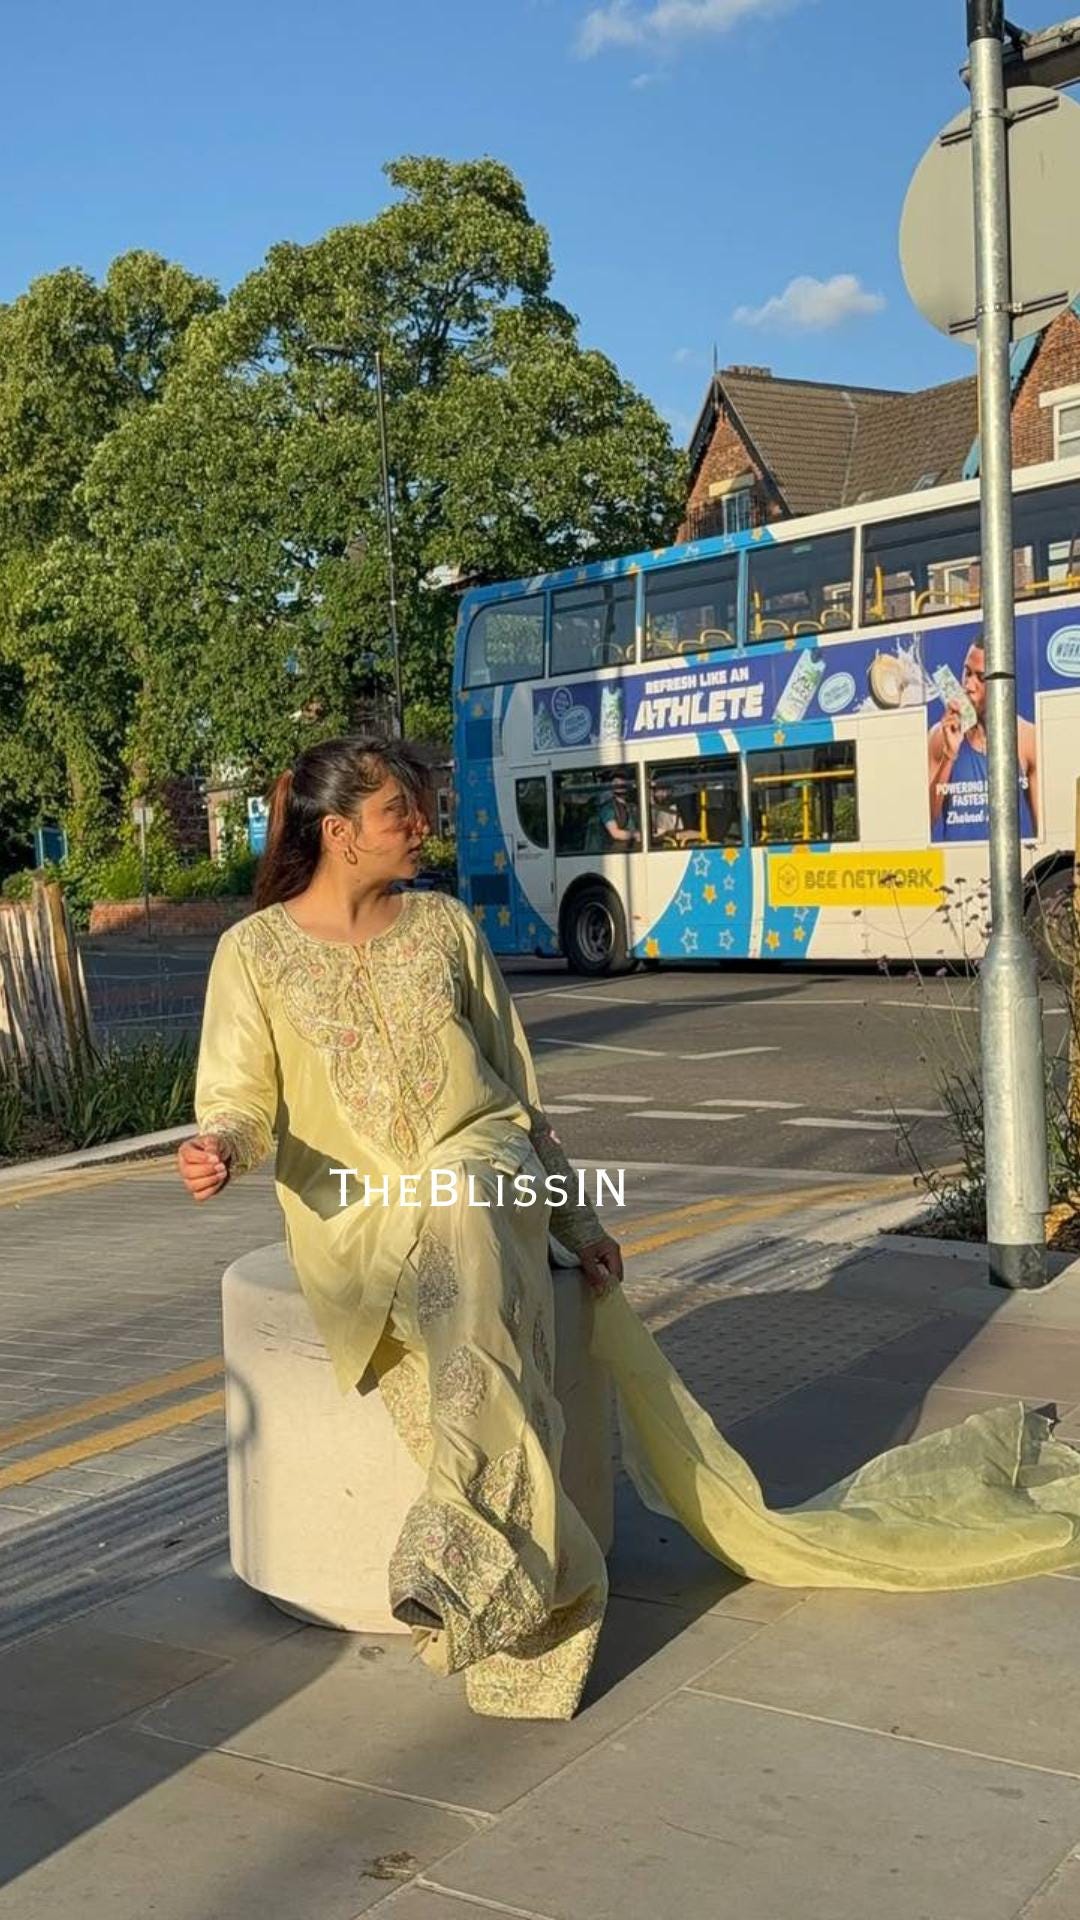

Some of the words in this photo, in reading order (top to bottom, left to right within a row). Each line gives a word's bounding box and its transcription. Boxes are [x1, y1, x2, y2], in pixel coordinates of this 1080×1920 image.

[645, 674, 697, 695] REFRESH
[700, 669, 727, 687] LIKE
[730, 666, 749, 683] AN
[633, 682, 764, 731] ATHLETE
[936, 780, 983, 796] POWERING
[804, 869, 837, 889] BEE
